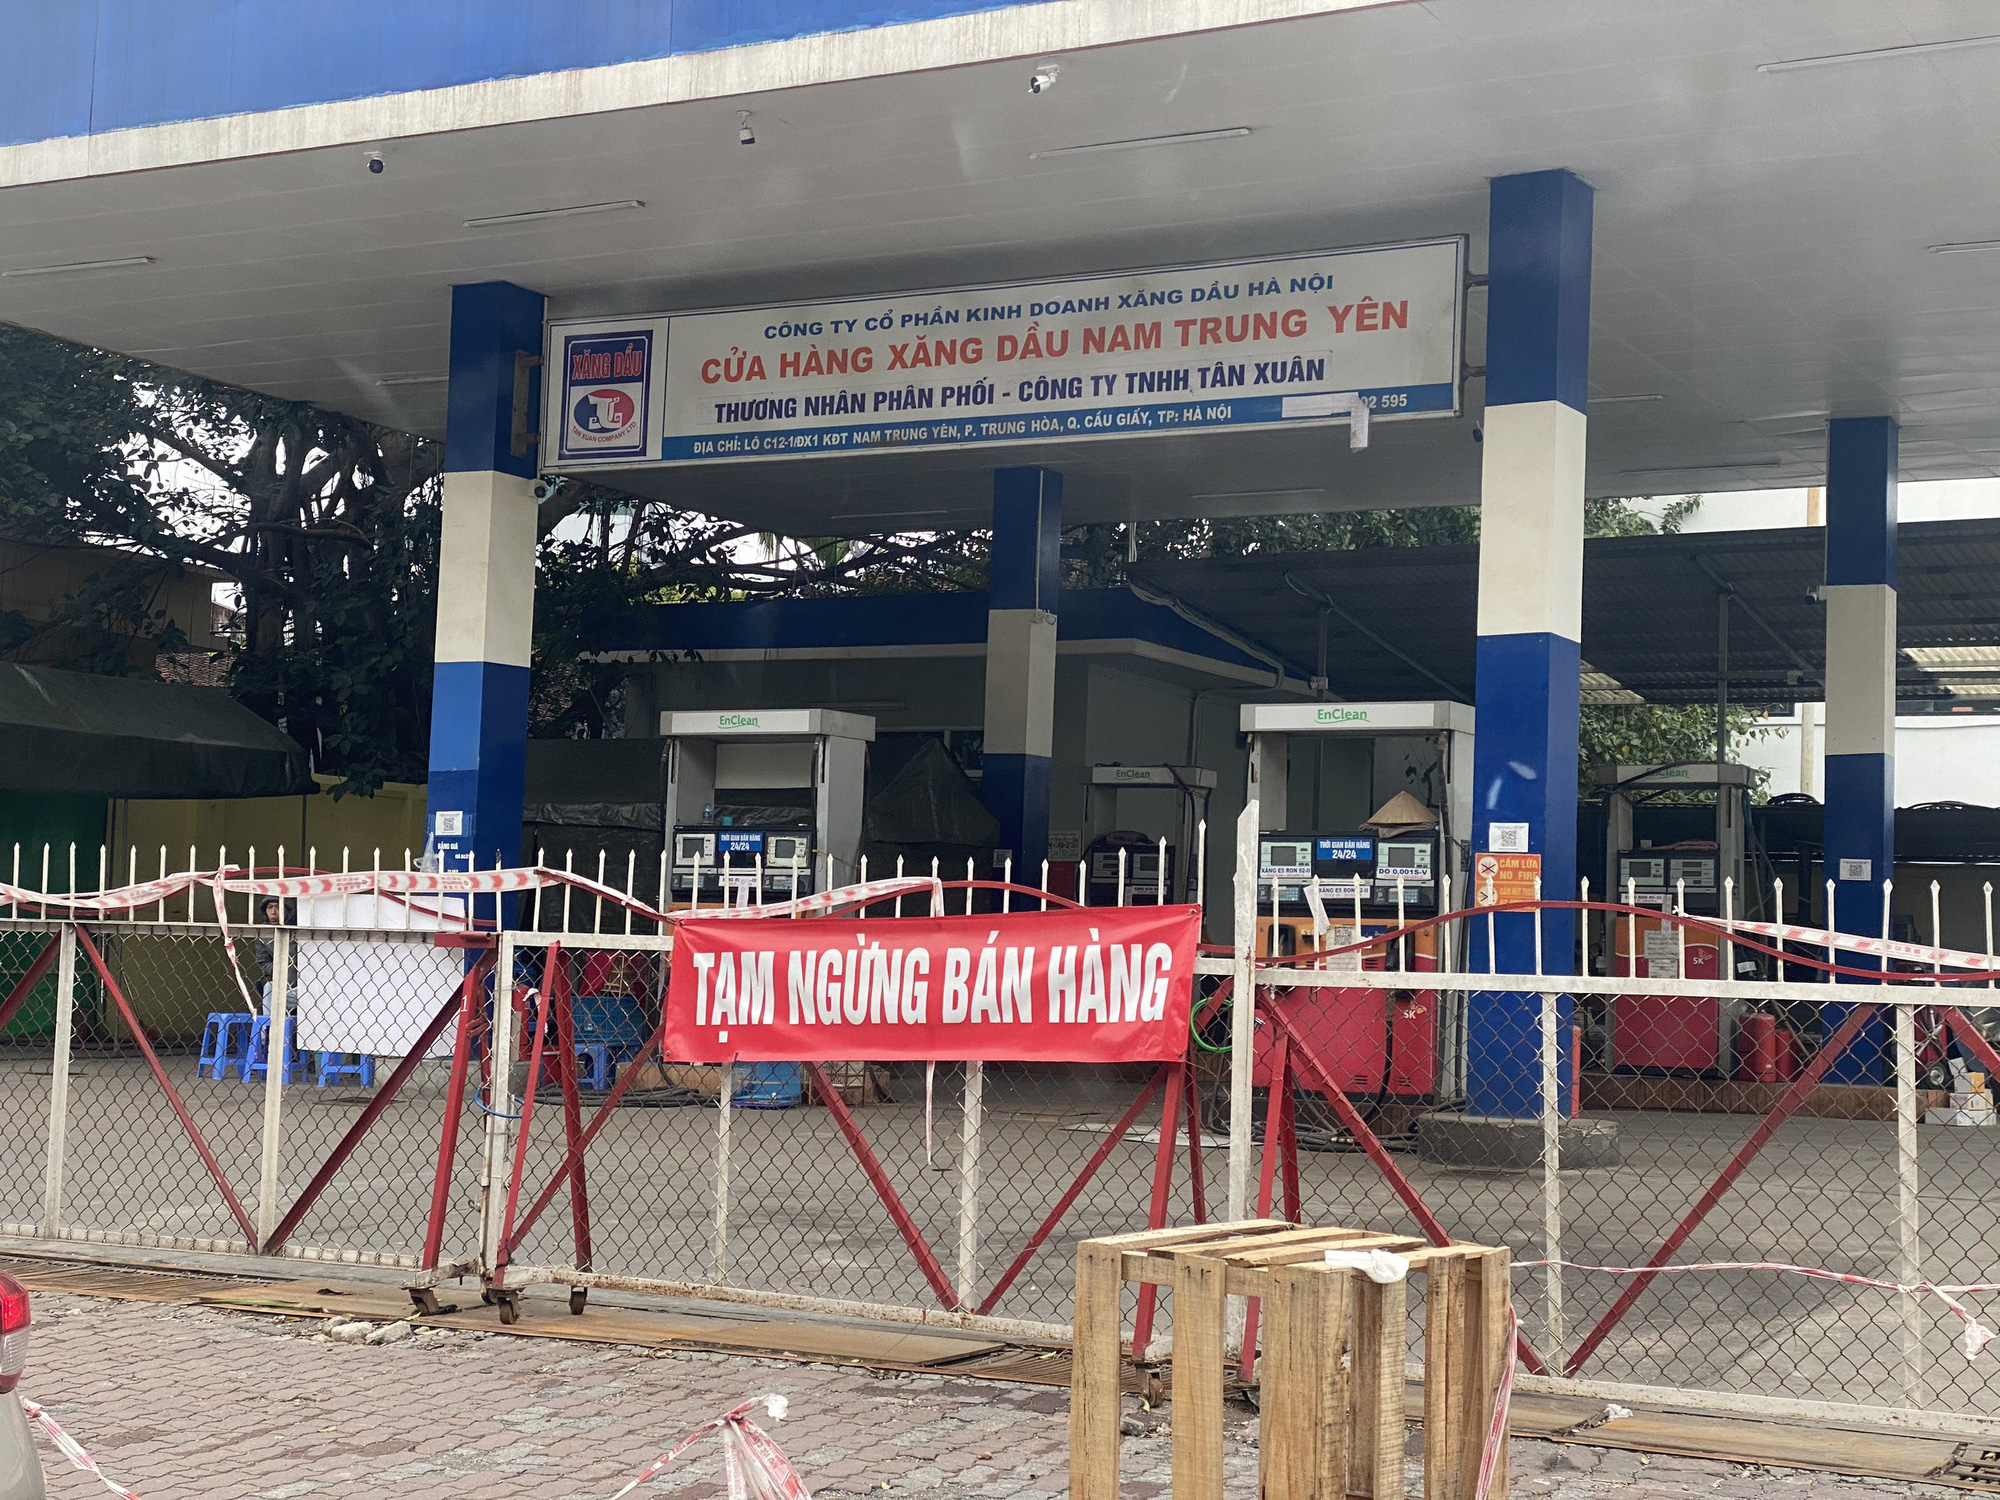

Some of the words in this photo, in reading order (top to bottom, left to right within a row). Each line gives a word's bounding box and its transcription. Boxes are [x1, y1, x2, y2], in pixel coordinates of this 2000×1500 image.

[764, 321, 823, 340] CÔNG
[830, 319, 857, 335] TY
[864, 308, 894, 333] CỔ
[900, 305, 959, 329] PHẦN
[967, 304, 1022, 323] KINH
[1030, 297, 1110, 317] DOANH
[1117, 287, 1183, 310] XĂNG
[1191, 280, 1239, 303] DẦU
[1248, 277, 1281, 298] HÀ
[1289, 271, 1333, 295] NỘI
[701, 346, 767, 384] CỬA
[779, 342, 874, 380] HÀNG
[887, 335, 983, 371] XĂNG
[995, 320, 1069, 362] DẦU
[1082, 322, 1162, 355] NAM
[1174, 307, 1308, 347] TRUNG
[1327, 296, 1409, 334] YÊN
[572, 348, 611, 380] XĂNG
[714, 399, 797, 424] THƯƠNG
[804, 390, 866, 418] NHÂN
[873, 384, 934, 414] PHÂN
[940, 377, 994, 409] PHỐI
[1018, 374, 1082, 402] CÔNG
[1090, 374, 1117, 398] TY
[1124, 368, 1189, 394] TNHH
[1197, 361, 1245, 390] TÂN
[1253, 355, 1325, 385] XUÂN
[693, 440, 714, 455] ĐỊA
[717, 435, 741, 452] CHỈ:
[744, 435, 760, 451] LÔ
[822, 432, 848, 446] KĐT
[853, 430, 881, 444] NAM
[884, 427, 928, 442] TRUNG
[931, 423, 961, 440] YÊN,
[964, 425, 977, 437] P.
[980, 420, 1026, 435] TRUNG
[1031, 415, 1064, 432] HÒA,
[1067, 416, 1081, 430] Q.
[1116, 407, 1152, 427] GIẤY,
[1157, 410, 1179, 423] TP:
[1183, 406, 1203, 422] HÀ
[1206, 404, 1232, 422] NỘI
[1381, 393, 1408, 408] 595
[571, 425, 582, 439] TAN
[581, 432, 597, 443] XUAN
[597, 429, 629, 443] COMPANY
[626, 421, 637, 433] LTD
[719, 714, 759, 726] EnClean
[1317, 707, 1368, 720] EnClean
[1116, 769, 1151, 779] EnClean
[730, 842, 750, 851] 24/24
[1332, 849, 1356, 859] 24/24
[1499, 857, 1519, 868] CẤM
[1499, 871, 1513, 880] NO
[693, 950, 775, 1044] TẠM
[788, 933, 931, 1026] NGỪNG
[942, 929, 1036, 1024] BÁN
[1047, 928, 1173, 1024] HÀNG
[1403, 1010, 1416, 1020] SK
